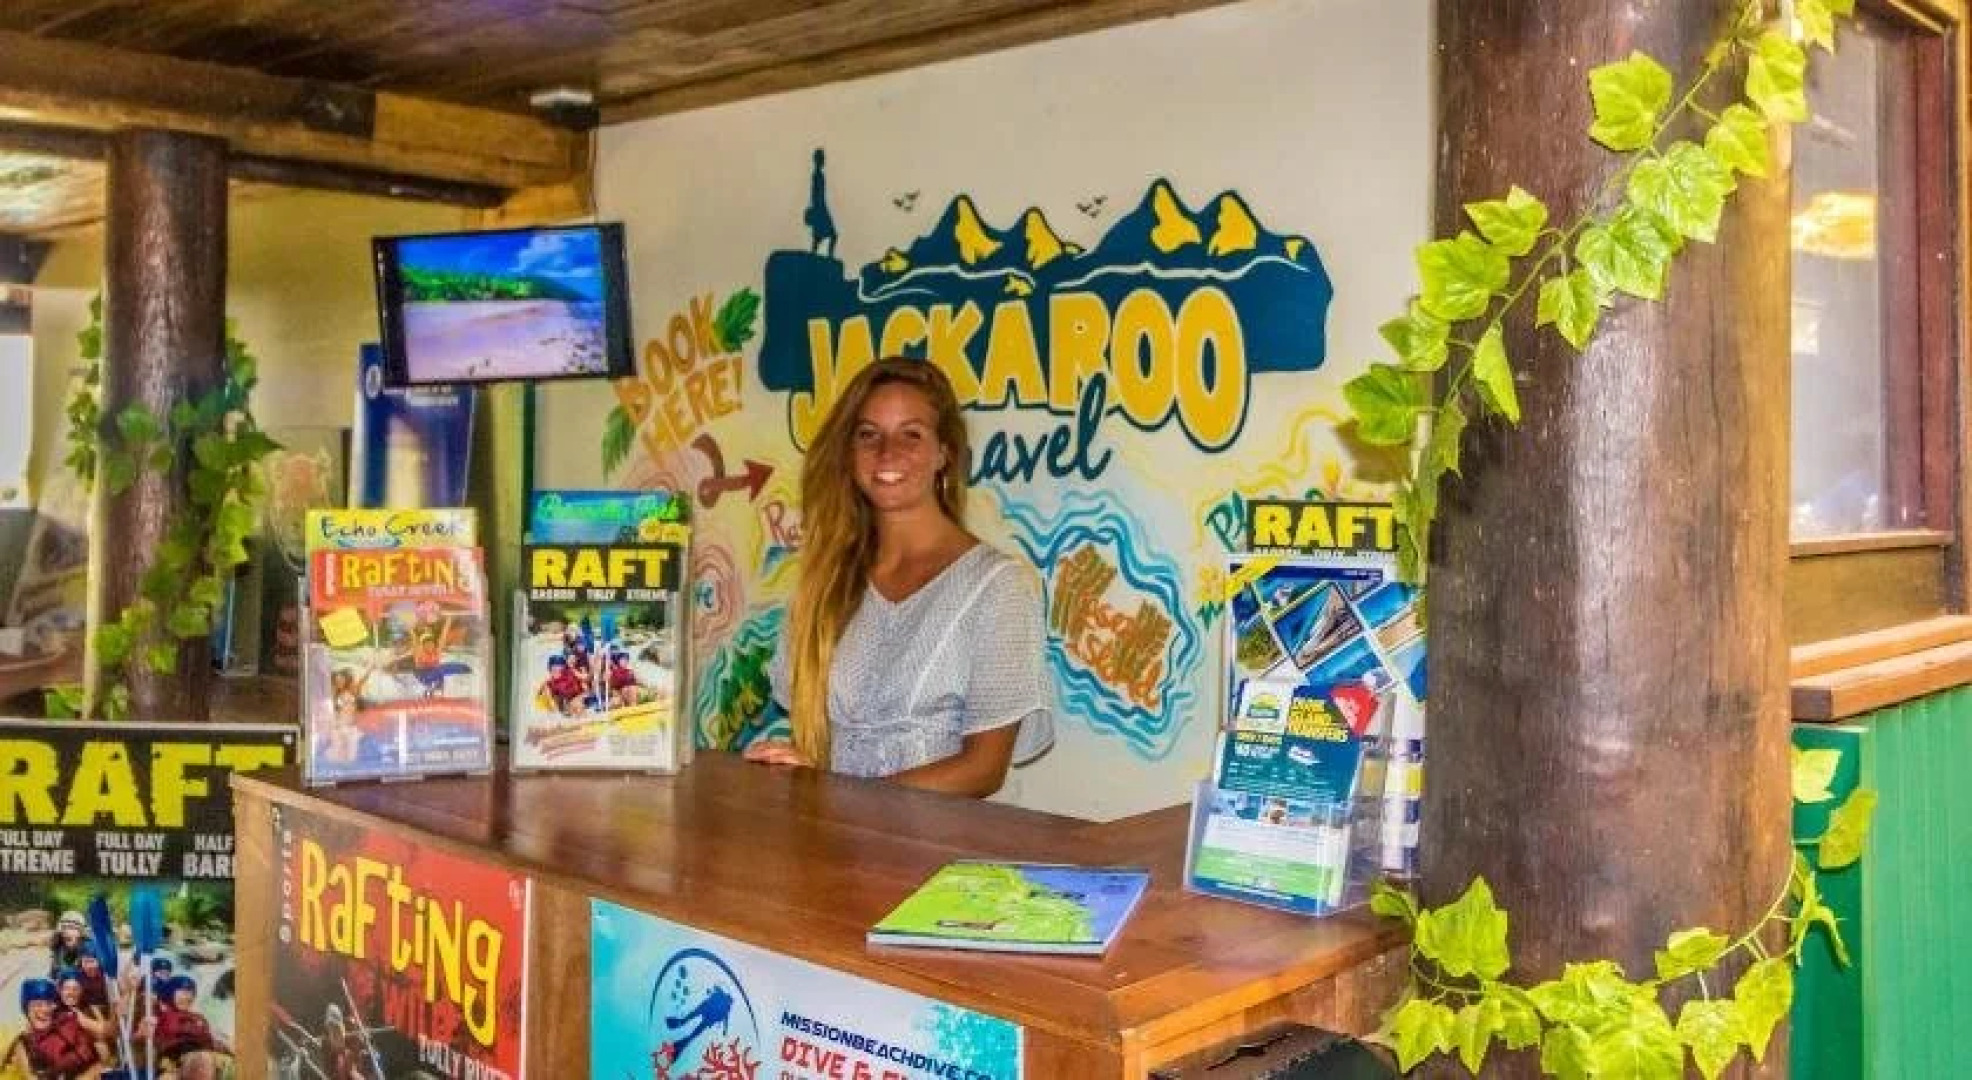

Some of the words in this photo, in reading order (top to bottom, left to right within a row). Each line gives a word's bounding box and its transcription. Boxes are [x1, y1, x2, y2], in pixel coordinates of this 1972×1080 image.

[613, 292, 721, 424] BOOK
[790, 287, 1249, 451] JACKAROO
[641, 356, 743, 470] HERE!
[968, 371, 1112, 485] avel
[322, 515, 376, 536] Echo
[1252, 505, 1392, 549] RAFT
[532, 549, 669, 588] RAFT
[96, 832, 130, 850] FULL
[134, 833, 165, 850] DAY
[195, 835, 233, 851] HALF
[98, 852, 163, 875] TULLY
[183, 855, 236, 877] BAR
[780, 1036, 849, 1080] DIVE
